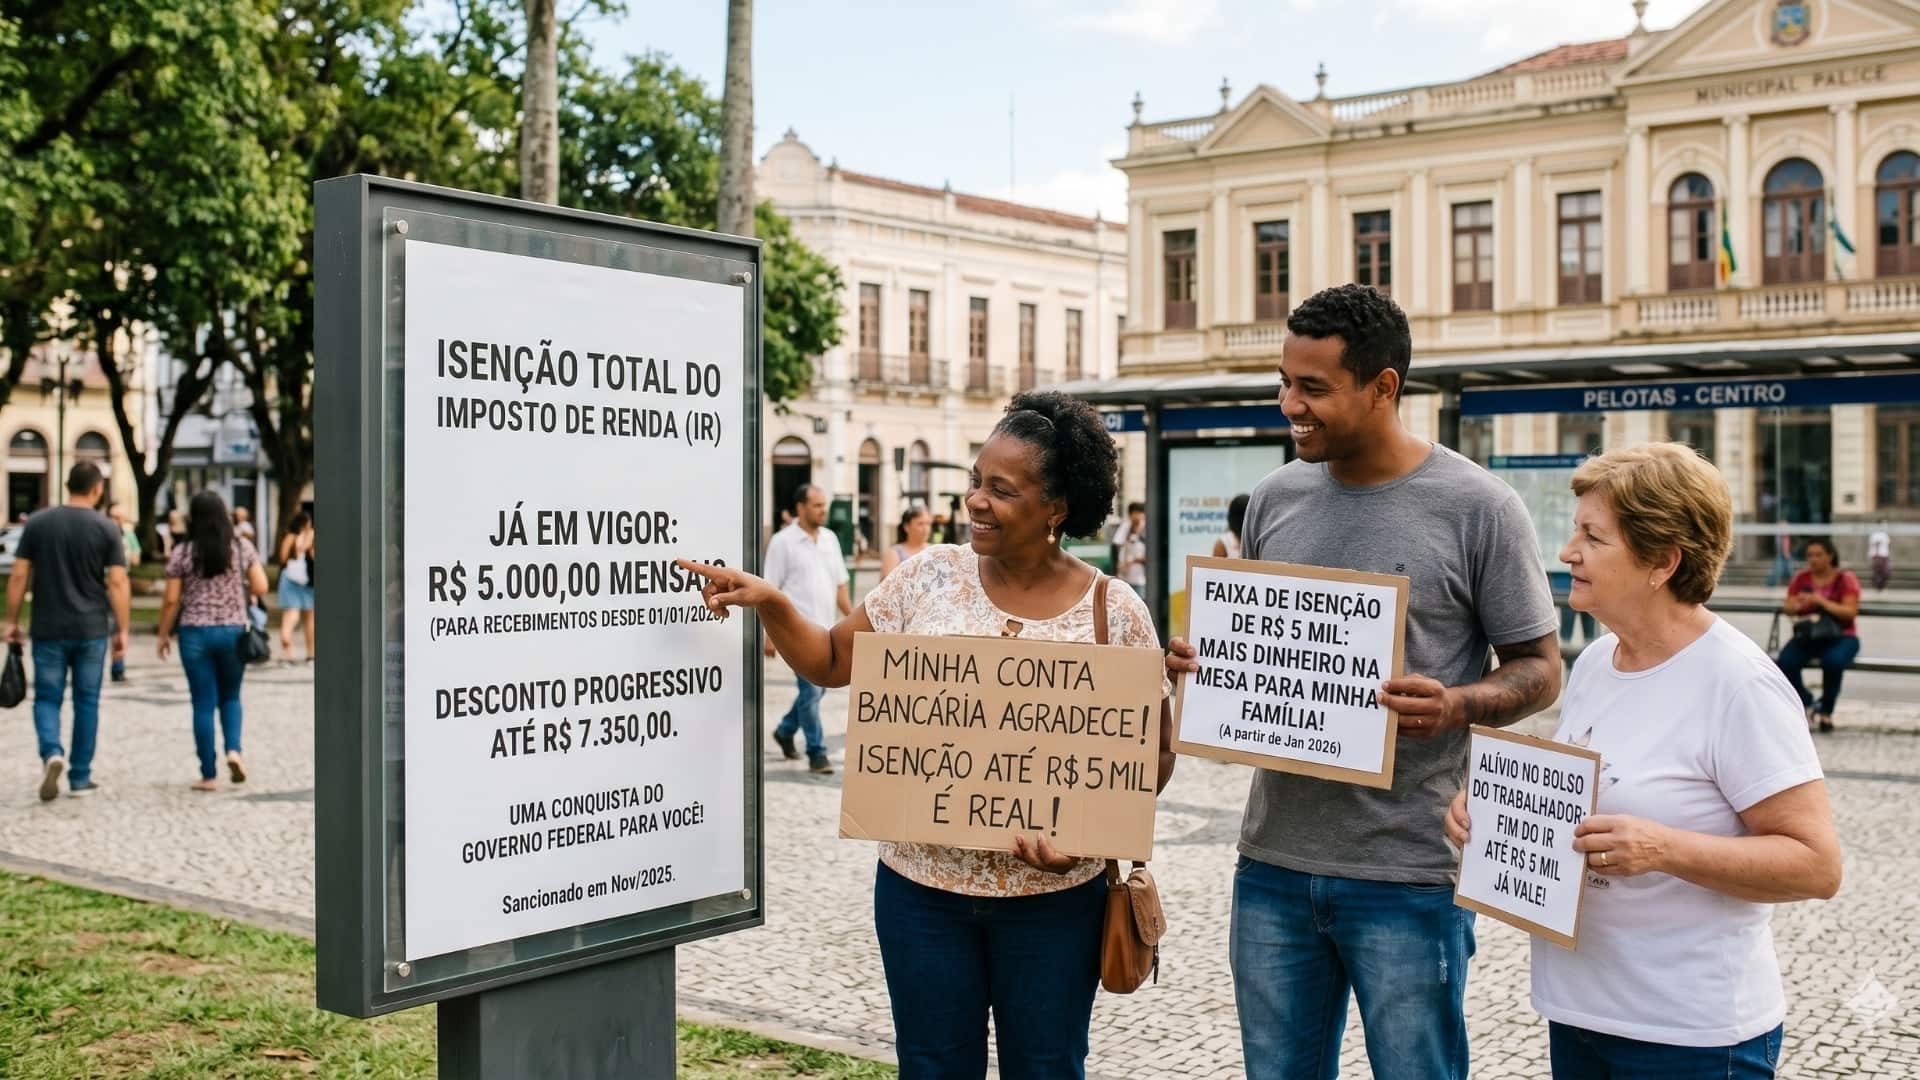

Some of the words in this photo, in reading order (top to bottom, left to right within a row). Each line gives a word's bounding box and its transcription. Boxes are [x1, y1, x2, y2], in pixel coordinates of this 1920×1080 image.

[1696, 74, 1797, 101] MUNICIPAL
[438, 339, 577, 394] ISENÇÃO
[587, 352, 677, 394] TOTAL
[686, 362, 720, 397] DO
[1584, 388, 1676, 408] PELOTAS
[1695, 383, 1786, 404] CENTRO
[438, 396, 556, 433] IMPOSTO
[566, 404, 595, 434] DE
[603, 407, 678, 439] RENDA
[686, 411, 721, 448] (IR)
[489, 501, 528, 547] JÁ
[538, 511, 577, 545] EM
[587, 511, 677, 544] VIGOR:
[429, 560, 466, 606] R$
[478, 562, 600, 604] 5.000,00
[610, 559, 726, 595] MENSA
[1206, 581, 1259, 606] FAIXA
[1265, 588, 1289, 609] DE
[1294, 590, 1381, 621] ISENÇÃO
[431, 616, 479, 641] (PARA
[484, 611, 597, 634] RECEBIMENTOS
[602, 608, 645, 627] DESDE
[1232, 613, 1255, 634] DE
[1261, 615, 1284, 640] R$
[1291, 620, 1302, 640] 5
[1308, 622, 1349, 645] MIL:
[884, 646, 979, 684] MINHA
[997, 657, 1095, 691] CONTA
[1199, 637, 1247, 662] MAIS
[1253, 643, 1346, 675] DINHEIRO
[1352, 657, 1380, 680] NA
[435, 678, 567, 719] DESCONTO
[575, 666, 722, 706] PROGRESSIVO
[1196, 665, 1248, 691] MESA
[1255, 673, 1304, 699] PARA
[1312, 681, 1378, 709] MINHA
[491, 718, 536, 759] ATÉ
[544, 717, 571, 754] R$
[578, 711, 677, 748] 7.350,00.
[858, 689, 986, 728] BANCÁRIA
[999, 701, 1149, 745] AGRADECE!
[1242, 700, 1324, 732] FAMÍLIA!
[1219, 724, 1231, 739] (A
[1234, 729, 1265, 743] partir
[1268, 732, 1281, 745] de
[1284, 735, 1304, 749] Jan
[1308, 738, 1341, 758] 2026)
[859, 743, 972, 783] ISENÇÃO
[984, 746, 1036, 783] ATÉ
[1047, 754, 1079, 789] R$
[1085, 757, 1103, 789] 5
[1110, 761, 1152, 792] MIL
[1479, 752, 1518, 779] ALÍVIO
[1522, 762, 1539, 784] NO
[1543, 767, 1584, 795] BOLSO
[510, 801, 547, 825] UMA
[552, 788, 640, 820] CONQUISTA
[644, 784, 663, 804] DO
[933, 784, 953, 824] É
[969, 794, 1060, 837] REAL!
[1473, 779, 1489, 800] DO
[463, 832, 542, 863] GOVERNO
[548, 820, 615, 849] FEDERAL
[620, 813, 658, 837] PARA
[662, 801, 703, 829] VOCÊ!
[1497, 814, 1518, 838] FIM
[1522, 821, 1538, 843] DO
[1542, 827, 1554, 848] IR
[1485, 840, 1508, 863] ATÉ
[1510, 847, 1526, 871] R$
[1529, 853, 1536, 872] 5
[1539, 856, 1560, 881] MIL
[503, 882, 583, 914] Sancionado
[588, 882, 607, 898] em
[612, 865, 675, 893] Nov/2025.
[1494, 870, 1509, 895] JÁ
[1514, 877, 1546, 907] VALE!
